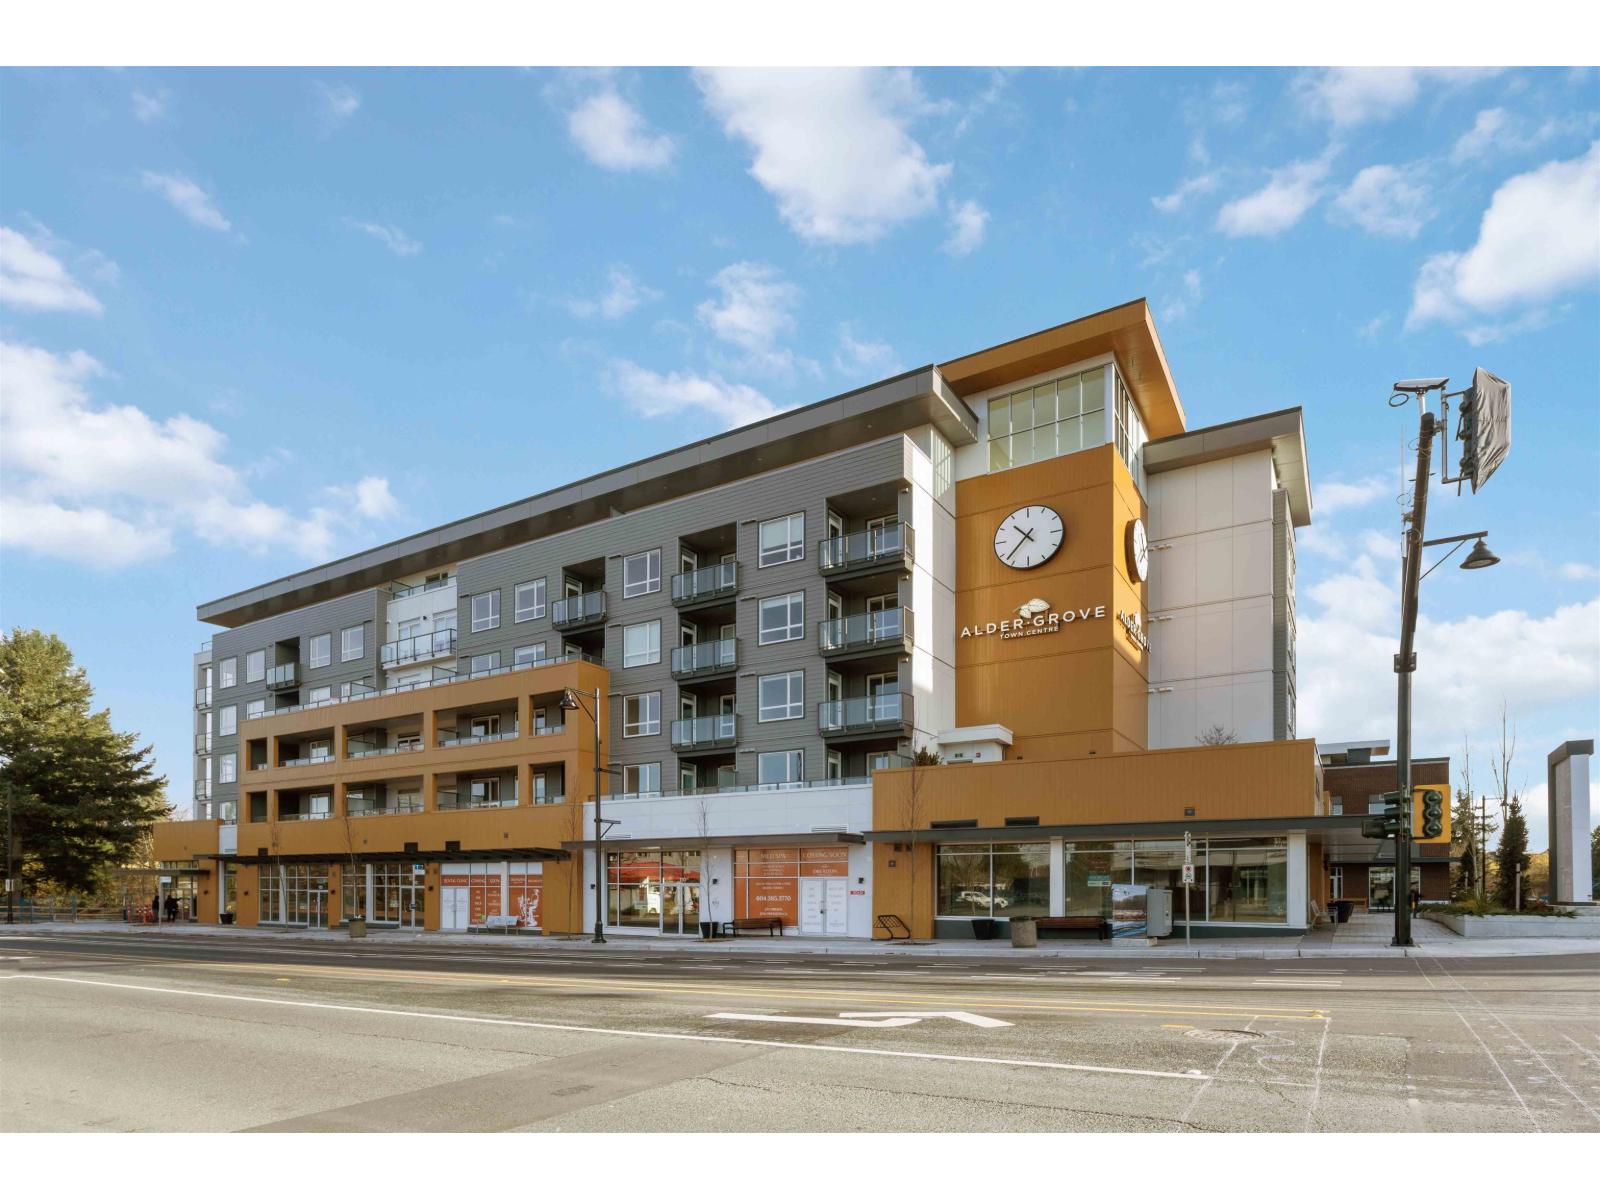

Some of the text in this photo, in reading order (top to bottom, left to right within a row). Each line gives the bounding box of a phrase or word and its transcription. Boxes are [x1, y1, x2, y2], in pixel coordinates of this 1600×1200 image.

[960, 605, 1106, 638] ALDER GROVE
[999, 626, 1059, 640] TOWN CENTRE
